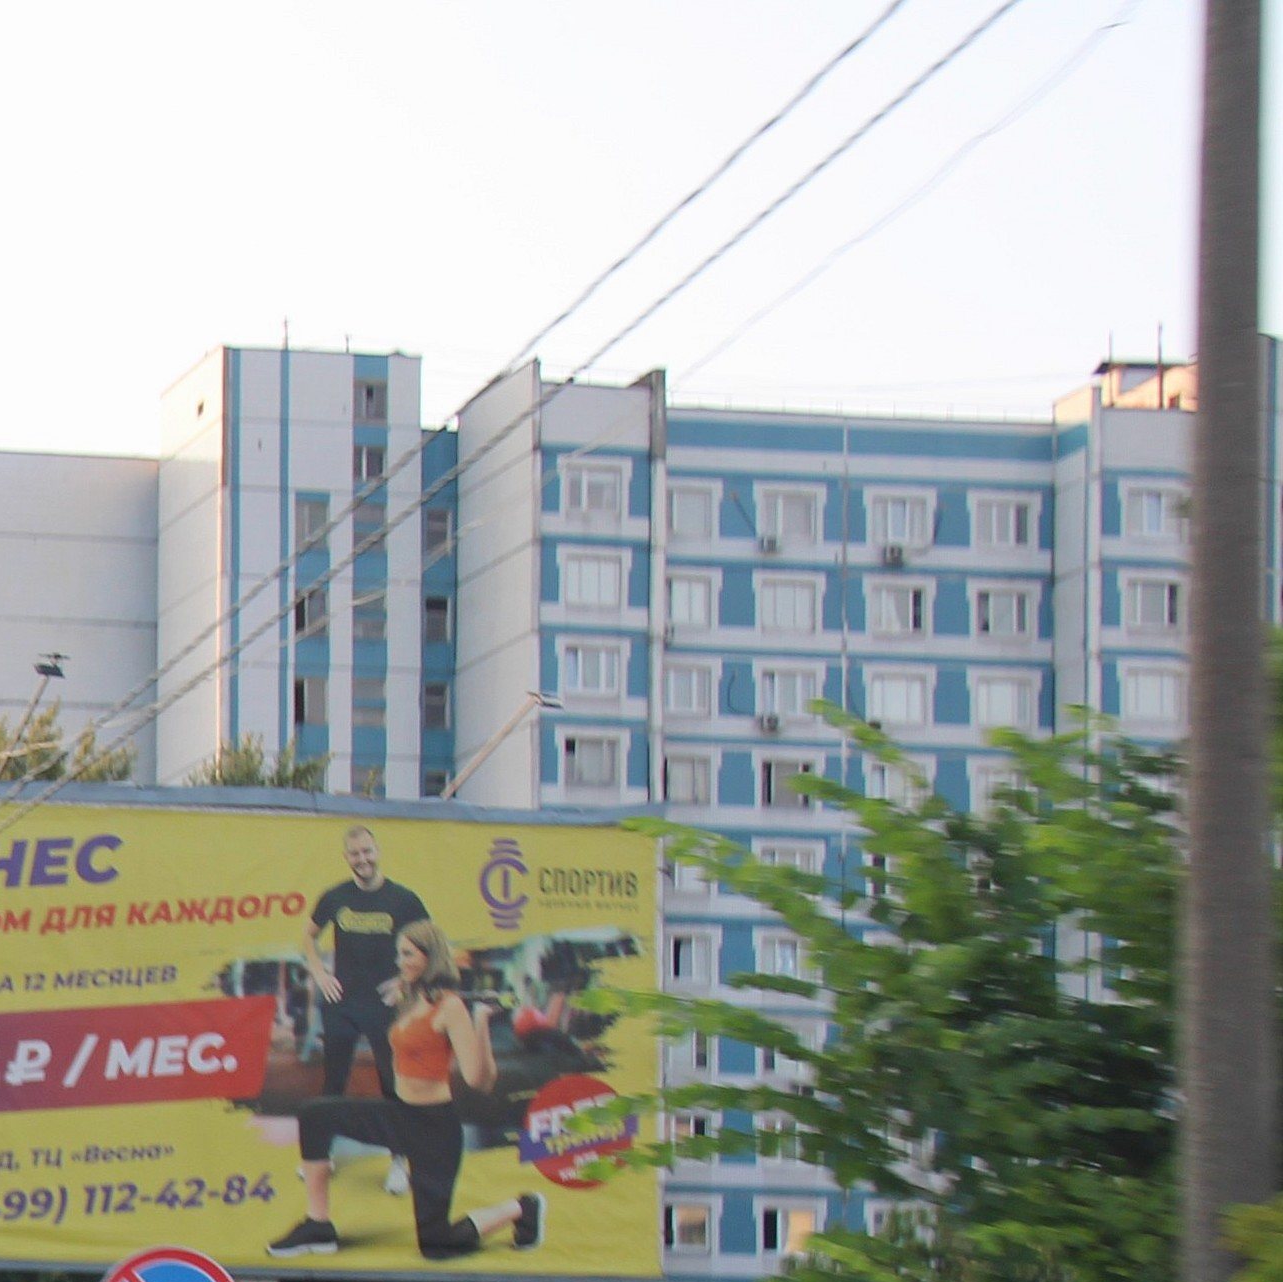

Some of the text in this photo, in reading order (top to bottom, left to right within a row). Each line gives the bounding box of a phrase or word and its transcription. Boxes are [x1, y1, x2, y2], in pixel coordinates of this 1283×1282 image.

[539, 868, 638, 897] СПОРТИВ
[39, 904, 117, 936] ДЛЯ
[127, 892, 307, 928] КАЖДОГО
[23, 973, 44, 992] 12
[53, 965, 178, 991] МЕСЯЦЕВ
[104, 1033, 238, 1081] МЕС.
[31, 1147, 63, 1169] ТЦ
[83, 1173, 275, 1214] 112-42-84
